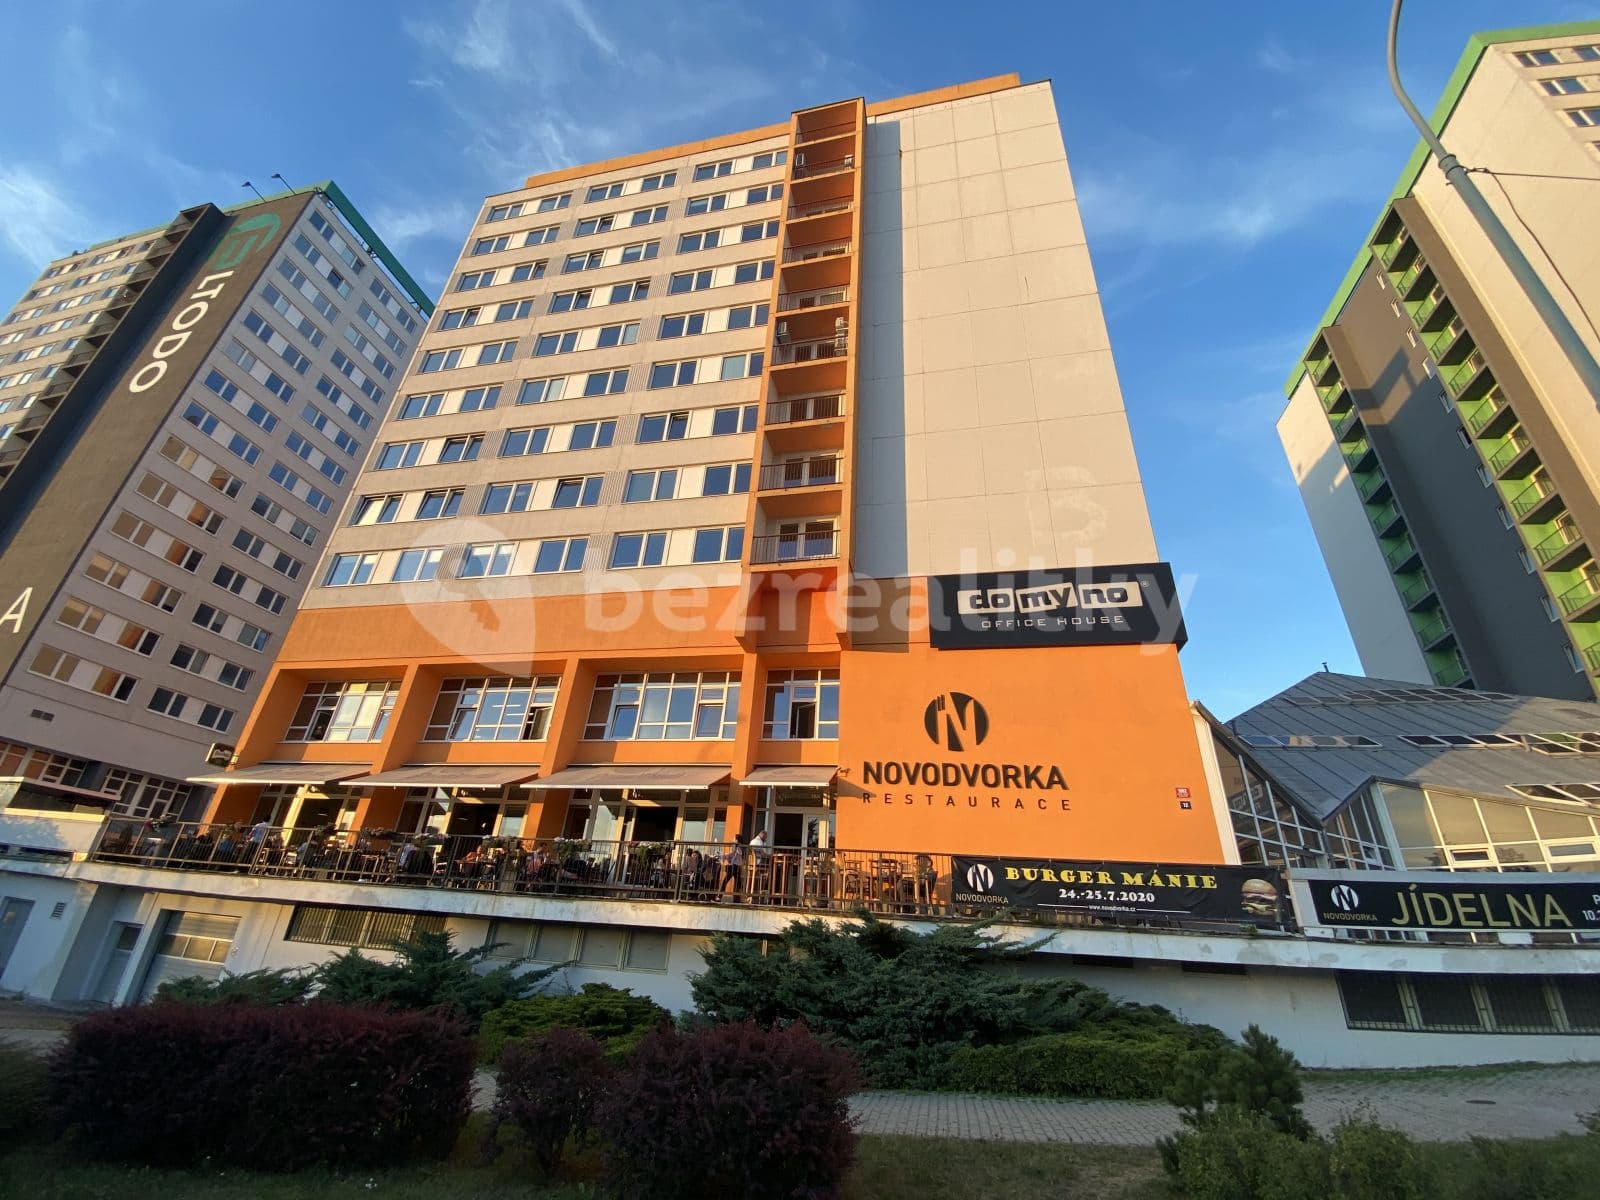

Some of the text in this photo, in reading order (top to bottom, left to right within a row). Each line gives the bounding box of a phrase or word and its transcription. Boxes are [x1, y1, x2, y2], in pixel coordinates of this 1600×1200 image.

[968, 586, 1130, 613] domyno
[981, 615, 1124, 629] OFFICE HOUSE
[863, 761, 1070, 790] NOVODVORKA
[862, 793, 1072, 810] RESTAURACE
[1003, 866, 1218, 889] BURGER MÁNIE
[955, 893, 1009, 905] NOVODVORKA
[1391, 884, 1574, 928] JÍDELNA
[1323, 912, 1378, 922] NOVODVORKA
